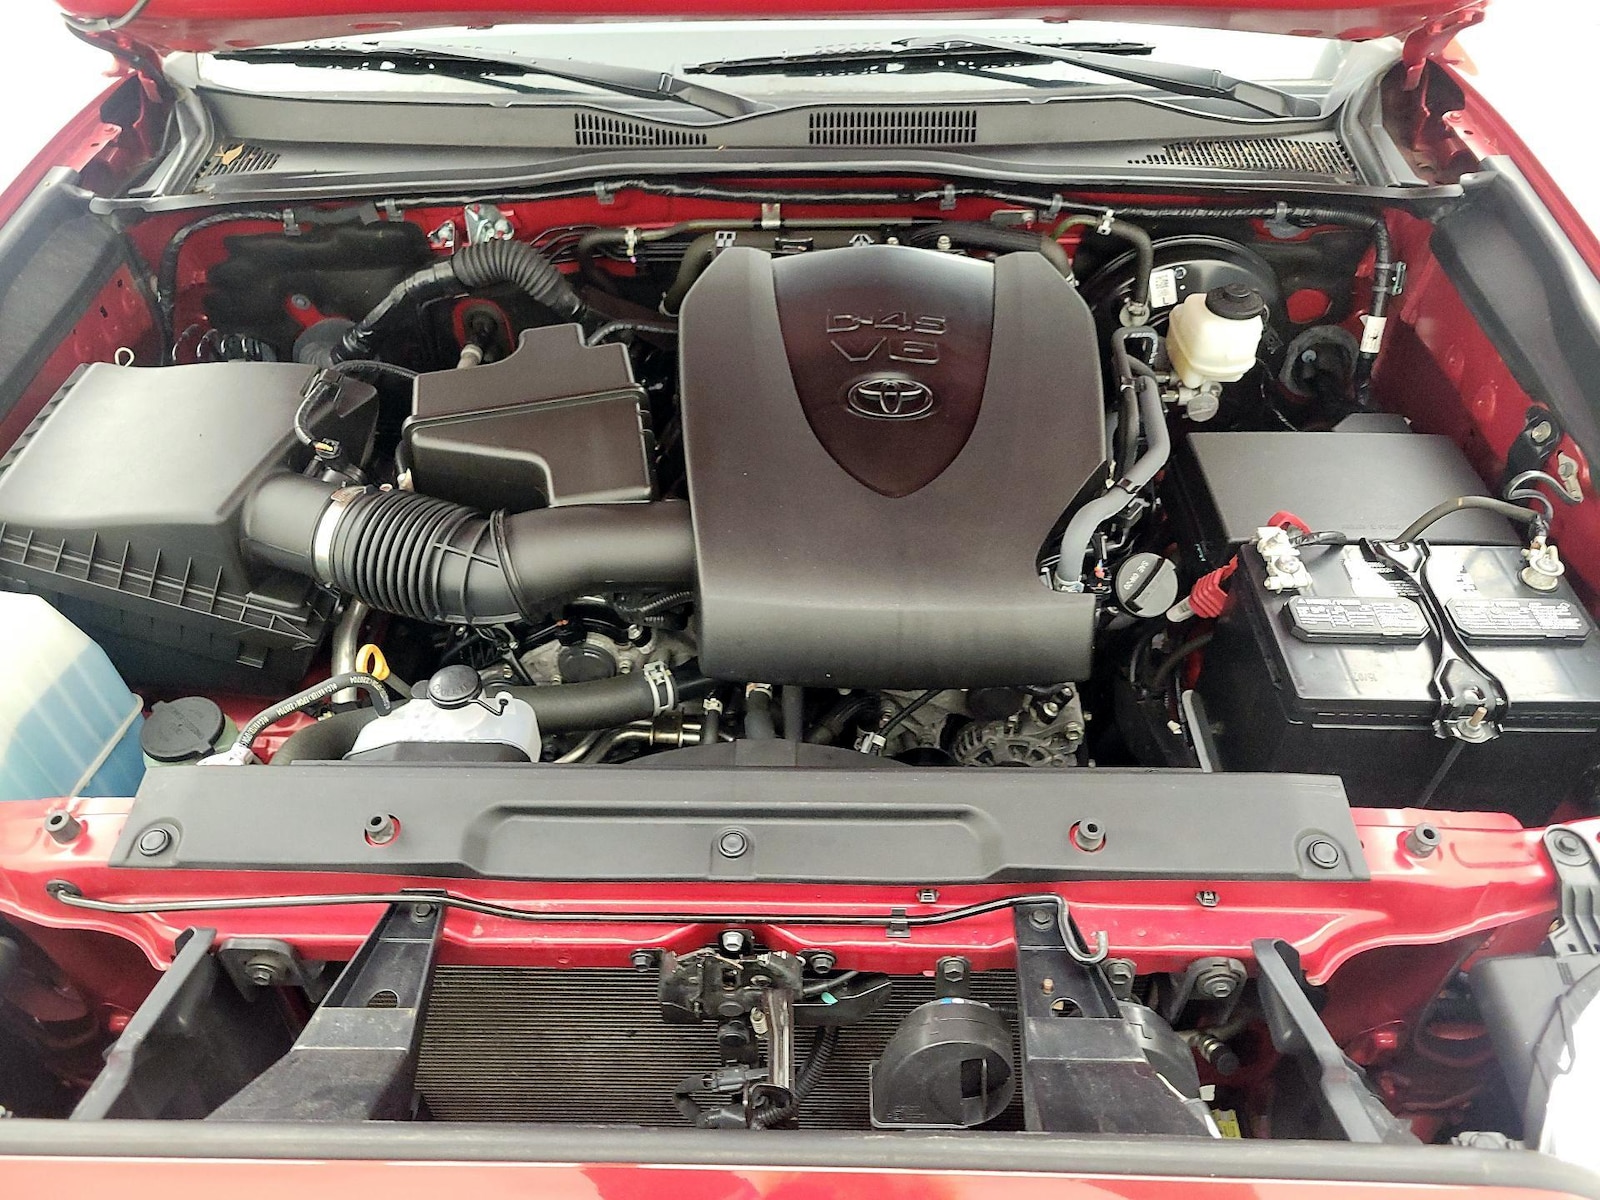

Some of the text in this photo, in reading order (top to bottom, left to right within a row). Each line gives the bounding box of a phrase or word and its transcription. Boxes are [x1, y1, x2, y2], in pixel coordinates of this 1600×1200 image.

[827, 310, 947, 335] D-4S
[830, 336, 940, 365] V6
[1136, 560, 1149, 573] SAE
